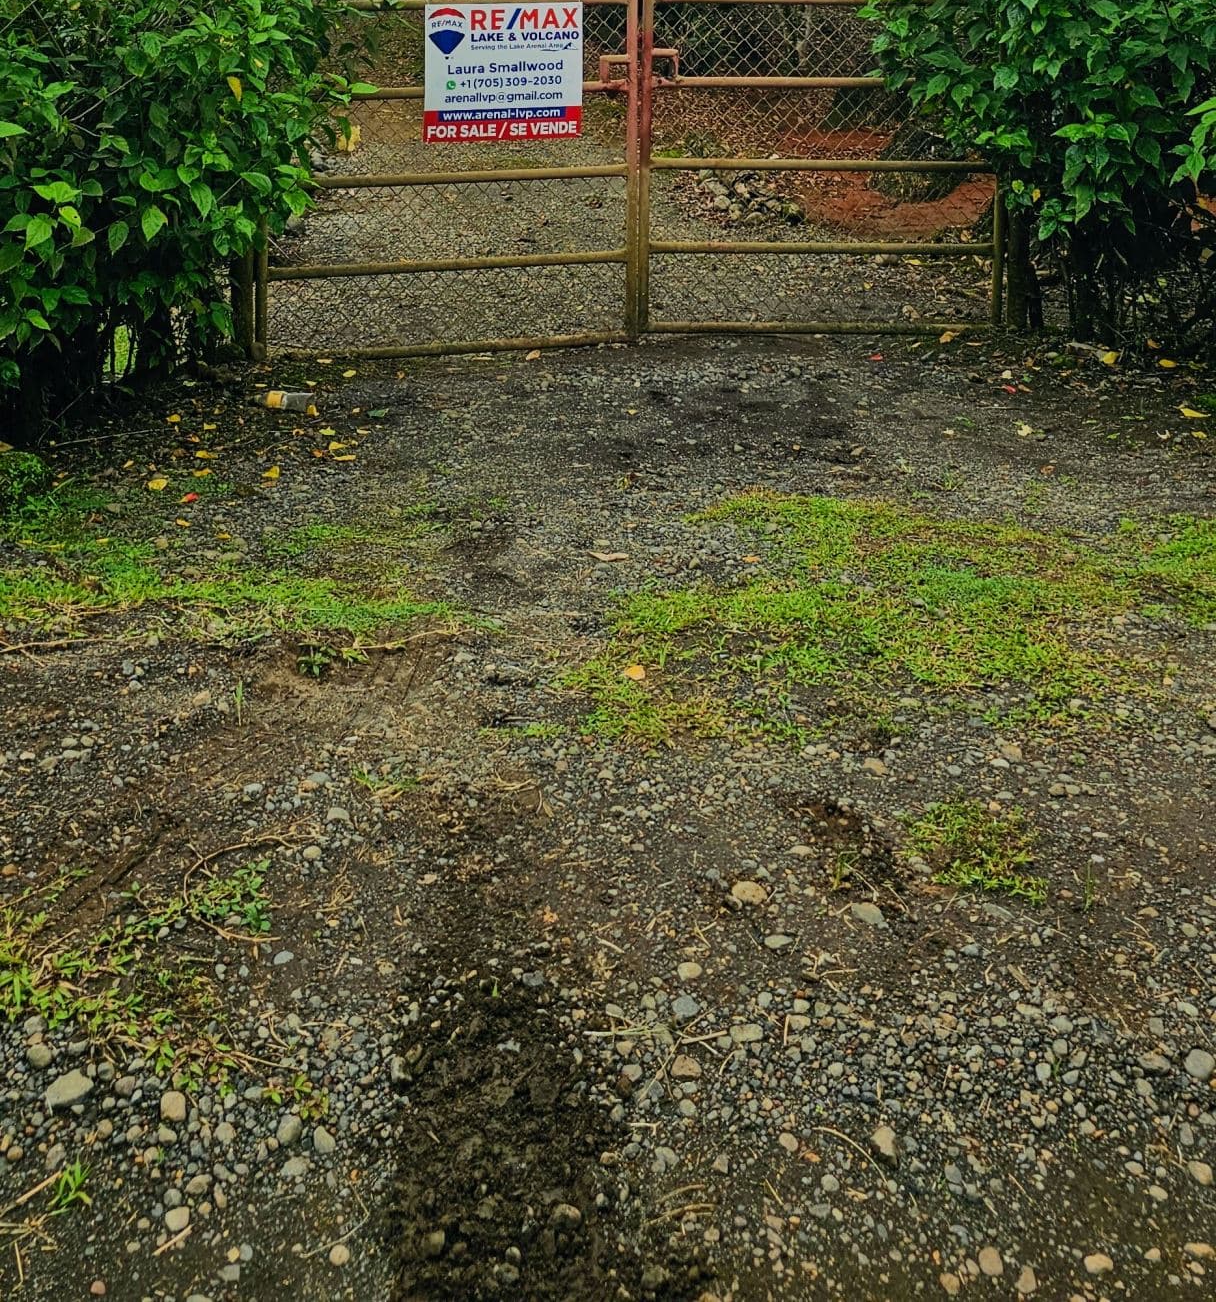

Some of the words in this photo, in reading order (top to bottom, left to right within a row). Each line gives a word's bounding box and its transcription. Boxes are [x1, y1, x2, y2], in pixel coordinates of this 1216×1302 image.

[432, 20, 463, 29] RE/MAX
[471, 8, 578, 30] RE/MAX
[471, 33, 504, 42] LAKE
[509, 33, 516, 41] &
[522, 31, 579, 40] VOLCANO
[448, 65, 484, 74] Laura
[489, 60, 563, 72] Smallwood
[445, 91, 563, 103] arenallvp@gmail.com
[443, 109, 560, 120] www.arenal-lvp.com
[427, 125, 457, 139] FOR
[461, 124, 496, 136] SALE
[499, 122, 507, 138] /
[510, 123, 527, 135] SE
[530, 121, 577, 134] VENDE
